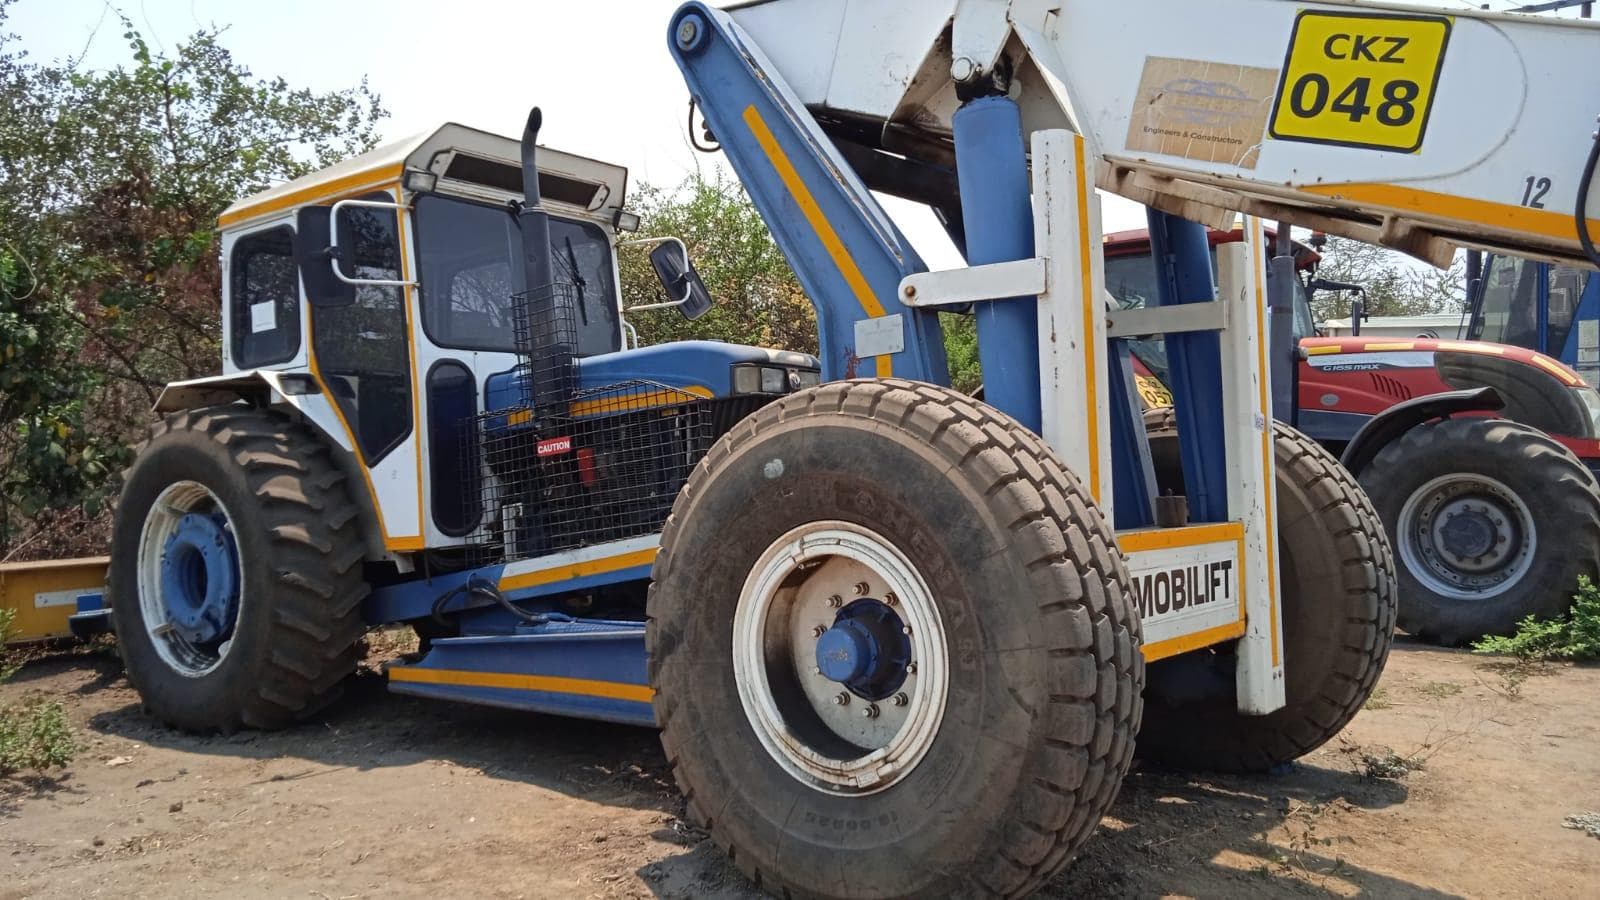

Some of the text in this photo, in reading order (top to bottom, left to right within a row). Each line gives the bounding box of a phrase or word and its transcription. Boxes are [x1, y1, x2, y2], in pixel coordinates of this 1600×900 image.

[1323, 33, 1410, 64] CKZ
[1290, 73, 1420, 127] 048
[1143, 126, 1243, 145] Engineers & Constructors
[1521, 176, 1552, 209] 12
[537, 440, 570, 454] CAUTION
[1131, 559, 1232, 619] MOBILIFT
